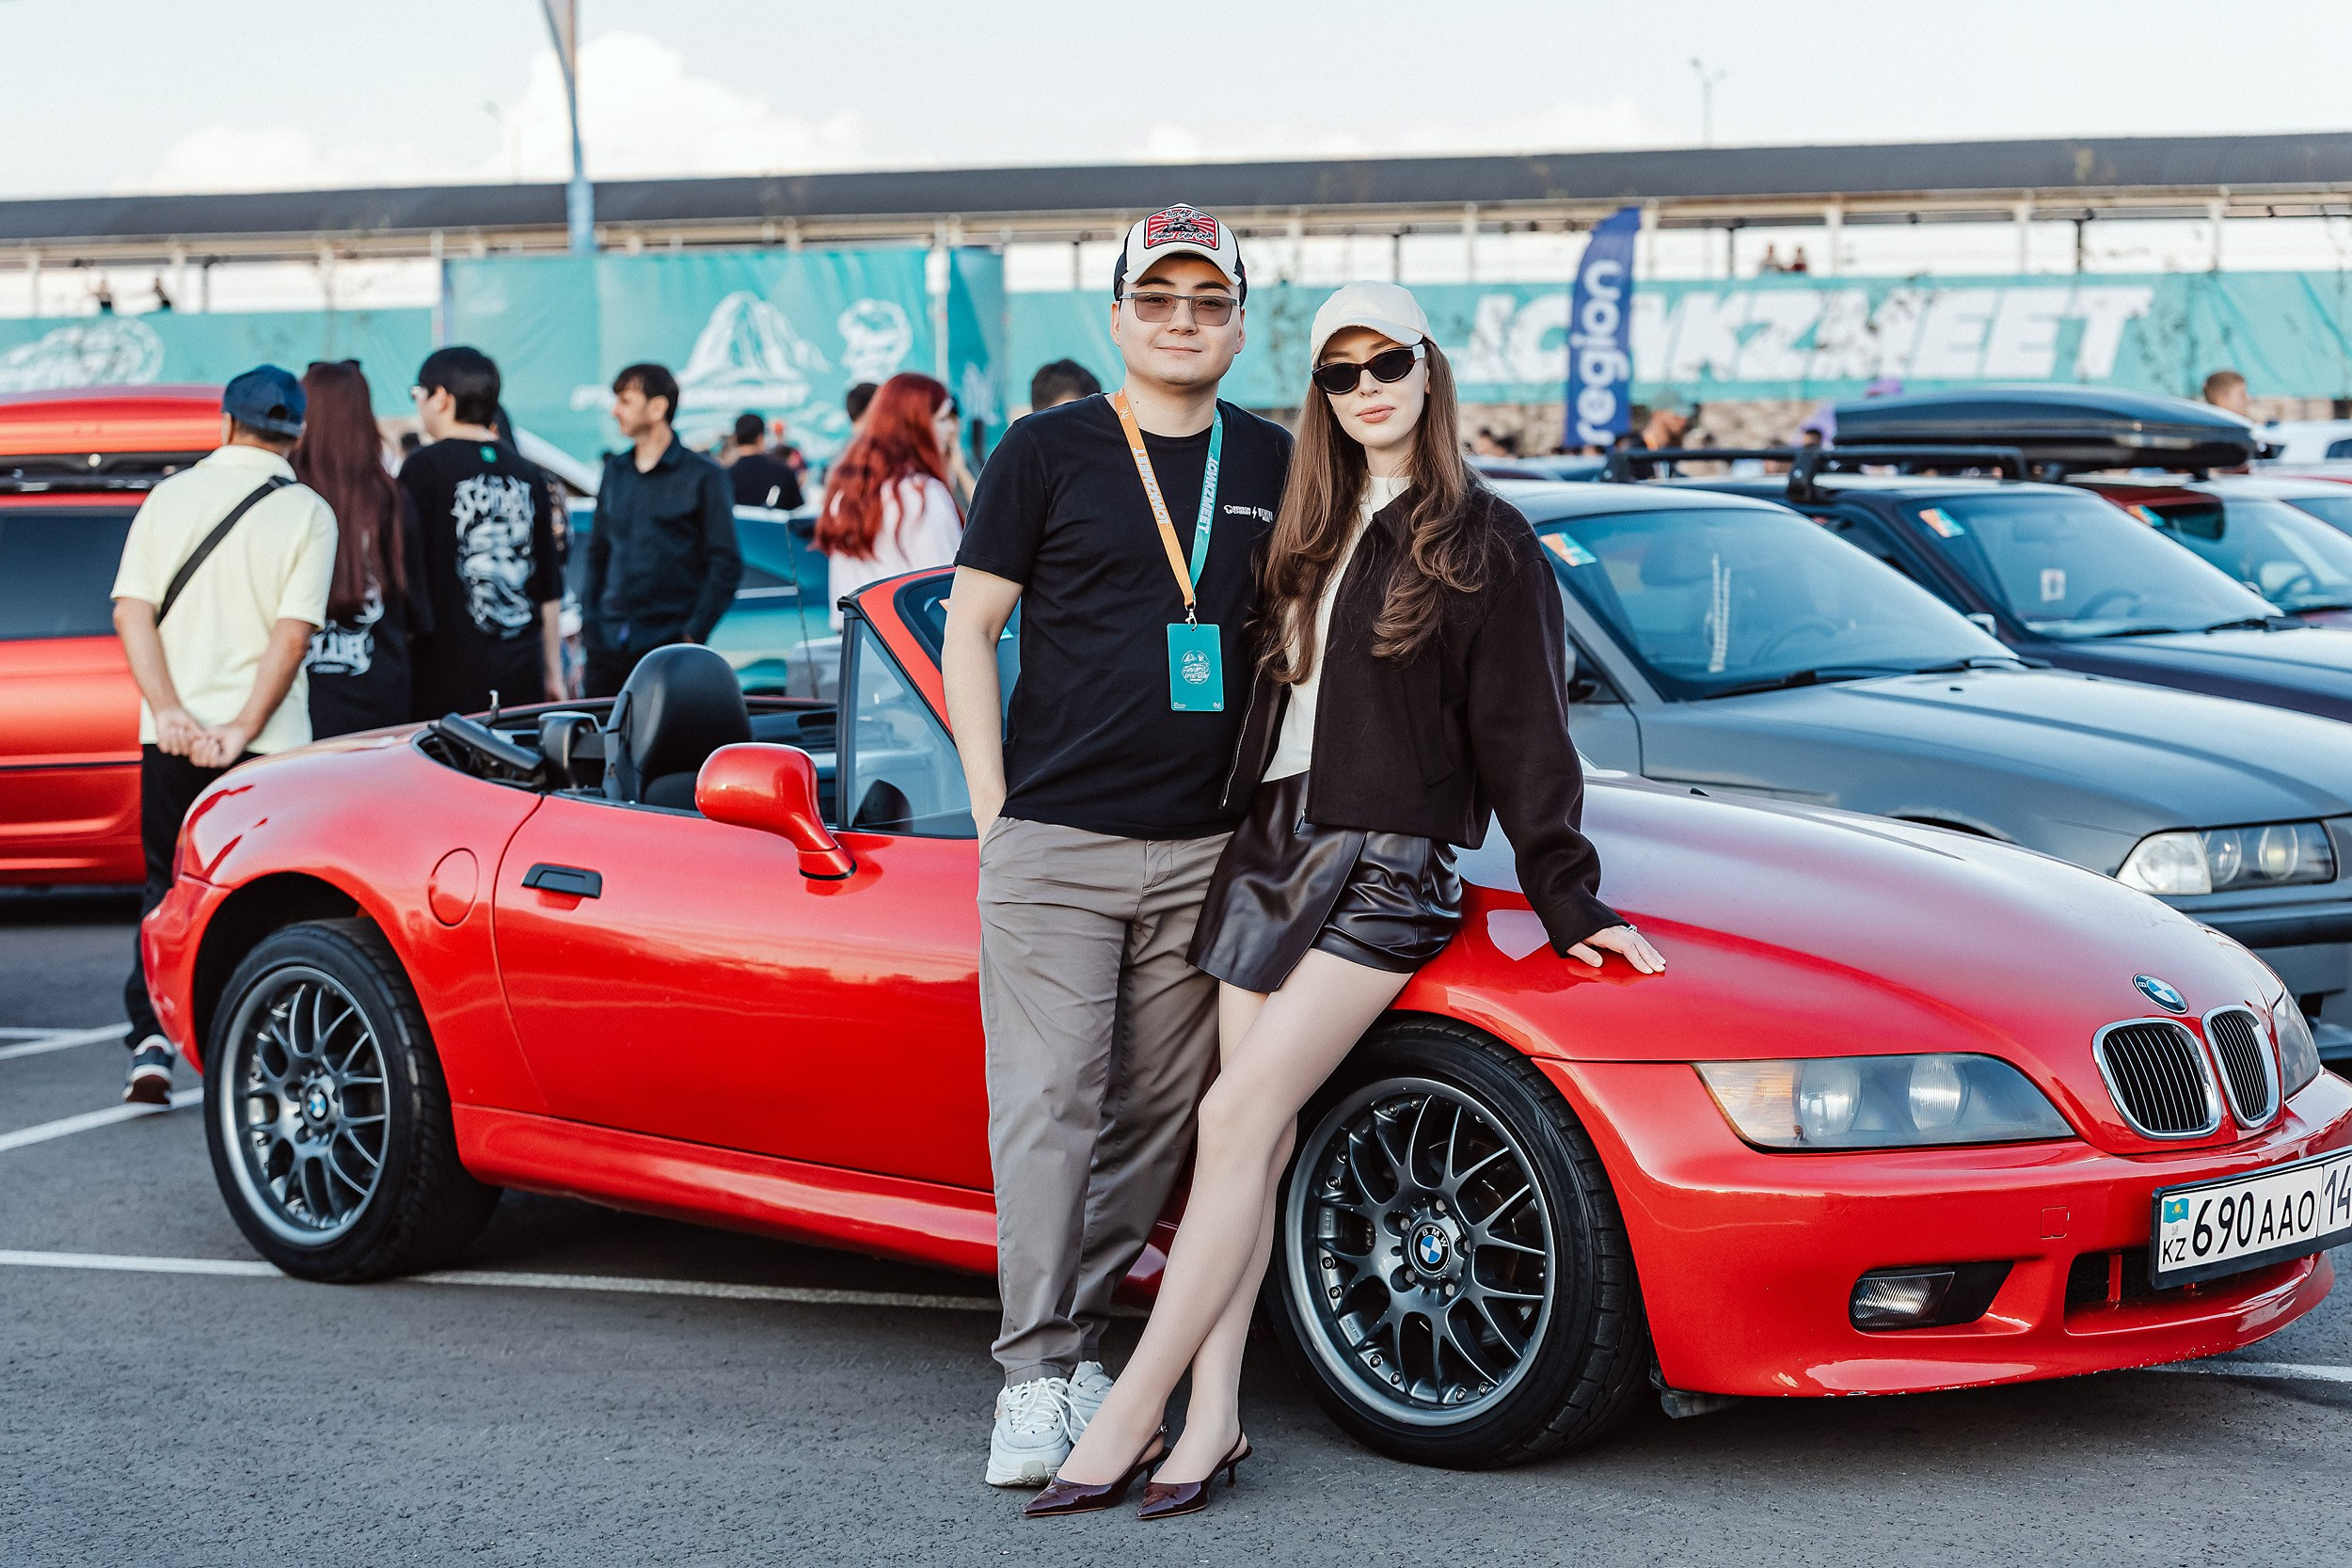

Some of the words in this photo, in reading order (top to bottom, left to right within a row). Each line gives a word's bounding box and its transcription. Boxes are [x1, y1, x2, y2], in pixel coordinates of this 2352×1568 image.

[1569, 259, 1629, 447] region
[2324, 1164, 2351, 1226] 14
[1422, 1227, 1449, 1247] BMW
[2162, 1238, 2186, 1264] KZ
